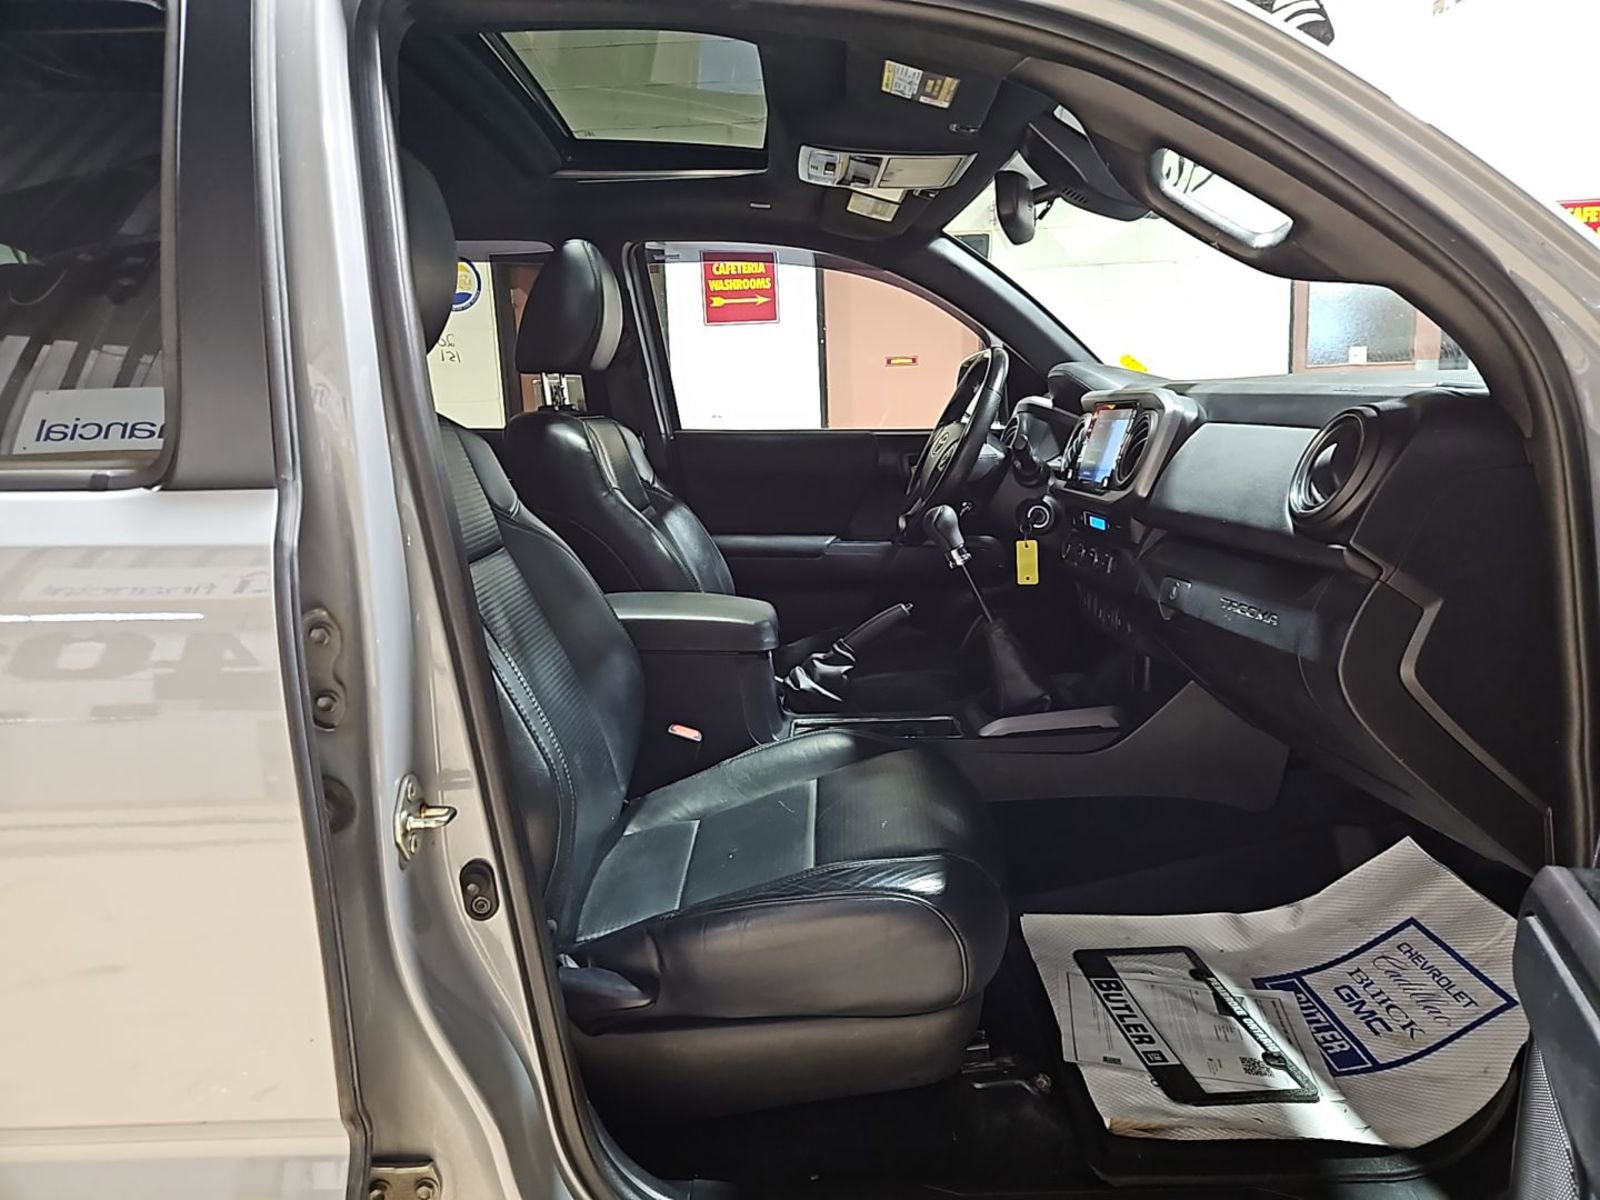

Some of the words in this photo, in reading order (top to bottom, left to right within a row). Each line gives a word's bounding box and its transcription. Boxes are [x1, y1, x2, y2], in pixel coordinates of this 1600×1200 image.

[708, 278, 772, 291] WASHROOMS
[712, 262, 766, 275] CAFETERIA
[1347, 968, 1426, 1041] BUICK
[1372, 954, 1451, 1027] Cadillac
[1396, 942, 1479, 1009] CHEVROLET
[1093, 979, 1157, 1045] BUTLER
[1333, 984, 1394, 1037] GMC
